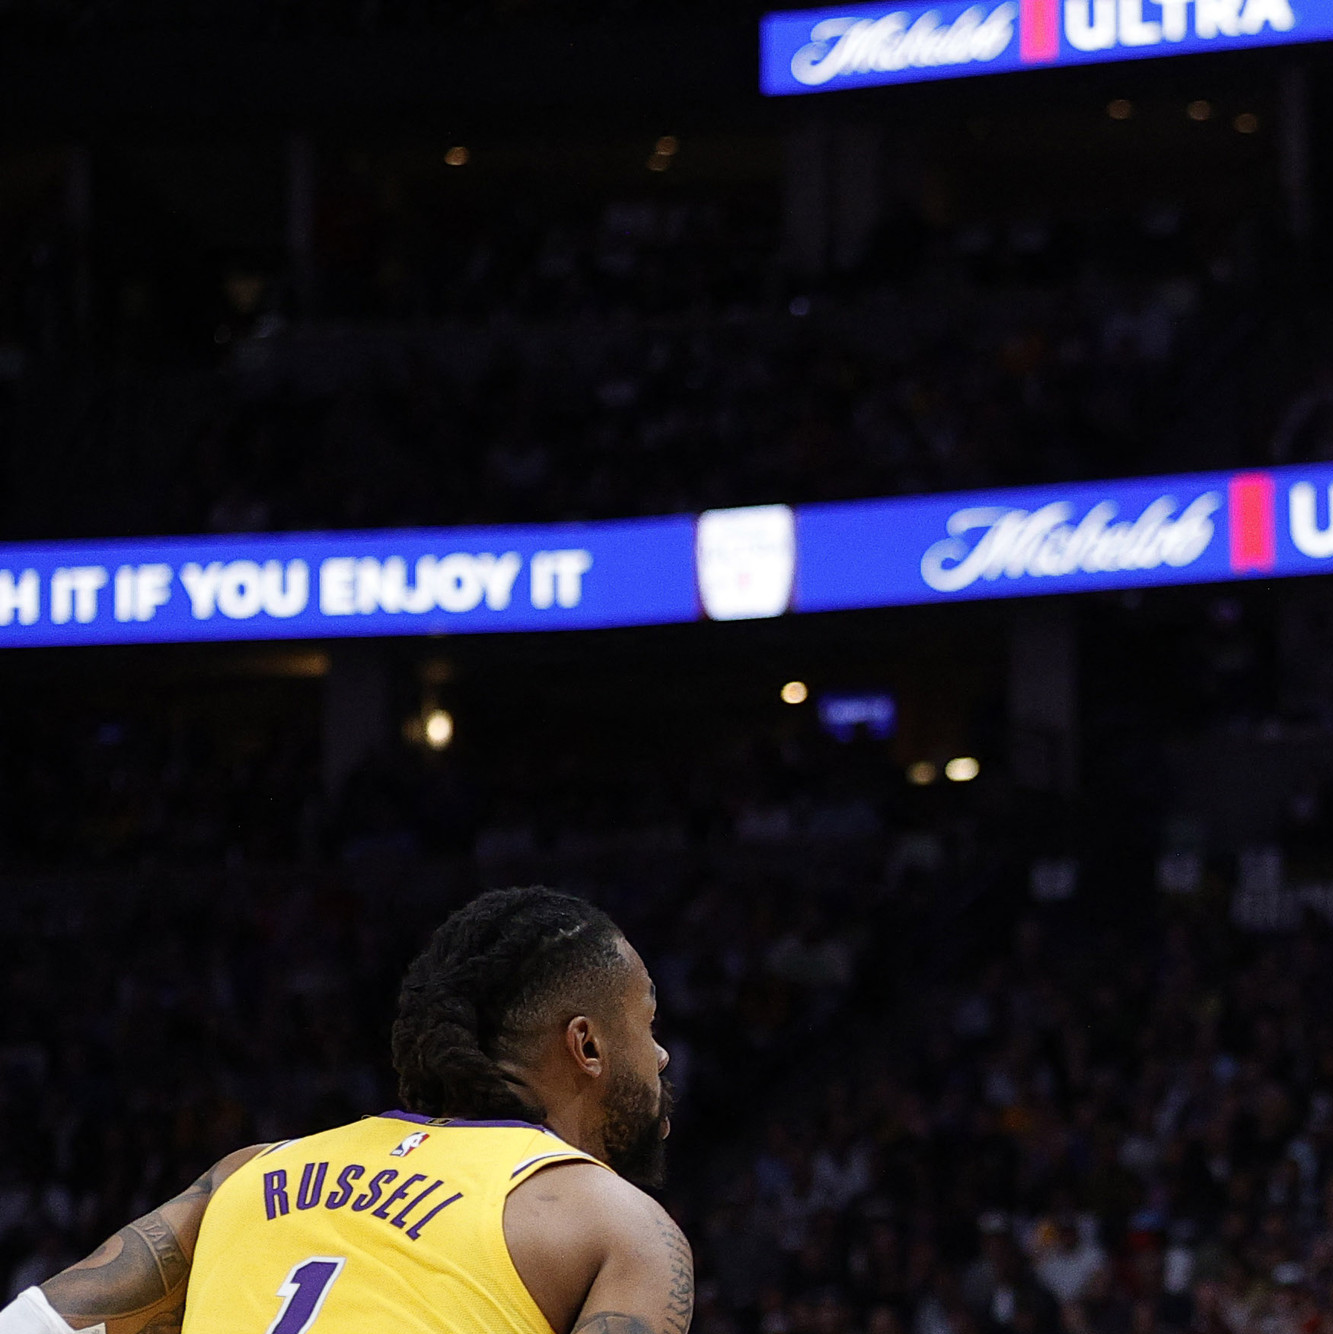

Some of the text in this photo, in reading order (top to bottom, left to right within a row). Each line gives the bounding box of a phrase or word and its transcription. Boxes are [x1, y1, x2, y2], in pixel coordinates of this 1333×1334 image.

[51, 565, 109, 625] IT
[114, 562, 174, 623] IF
[179, 558, 309, 620] YOU
[318, 550, 523, 618] ENJOY
[529, 548, 593, 610] IT
[263, 1161, 464, 1241] RUSSELL
